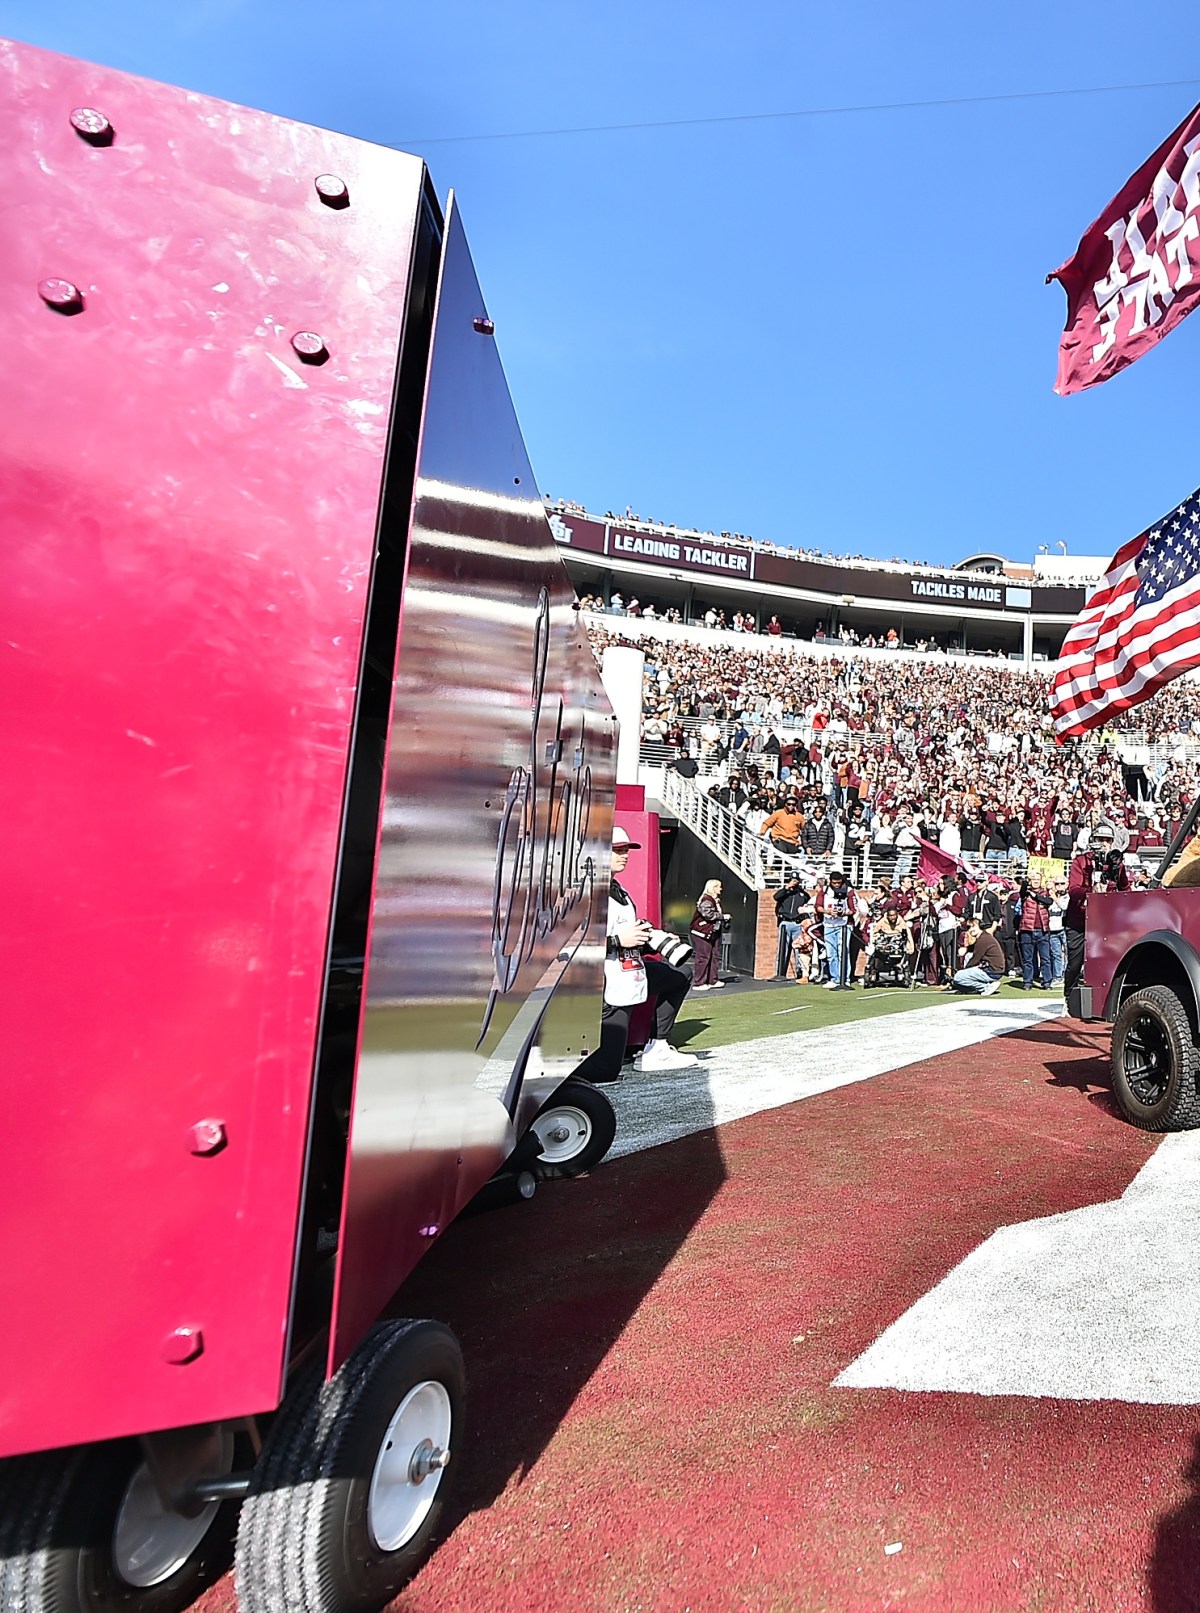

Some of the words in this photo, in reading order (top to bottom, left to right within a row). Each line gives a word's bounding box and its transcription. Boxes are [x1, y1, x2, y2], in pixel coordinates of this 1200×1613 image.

[614, 533, 680, 560] LEADING
[684, 546, 748, 571] TACKLER
[911, 580, 965, 599] TACKLES
[968, 586, 1001, 602] MADE
